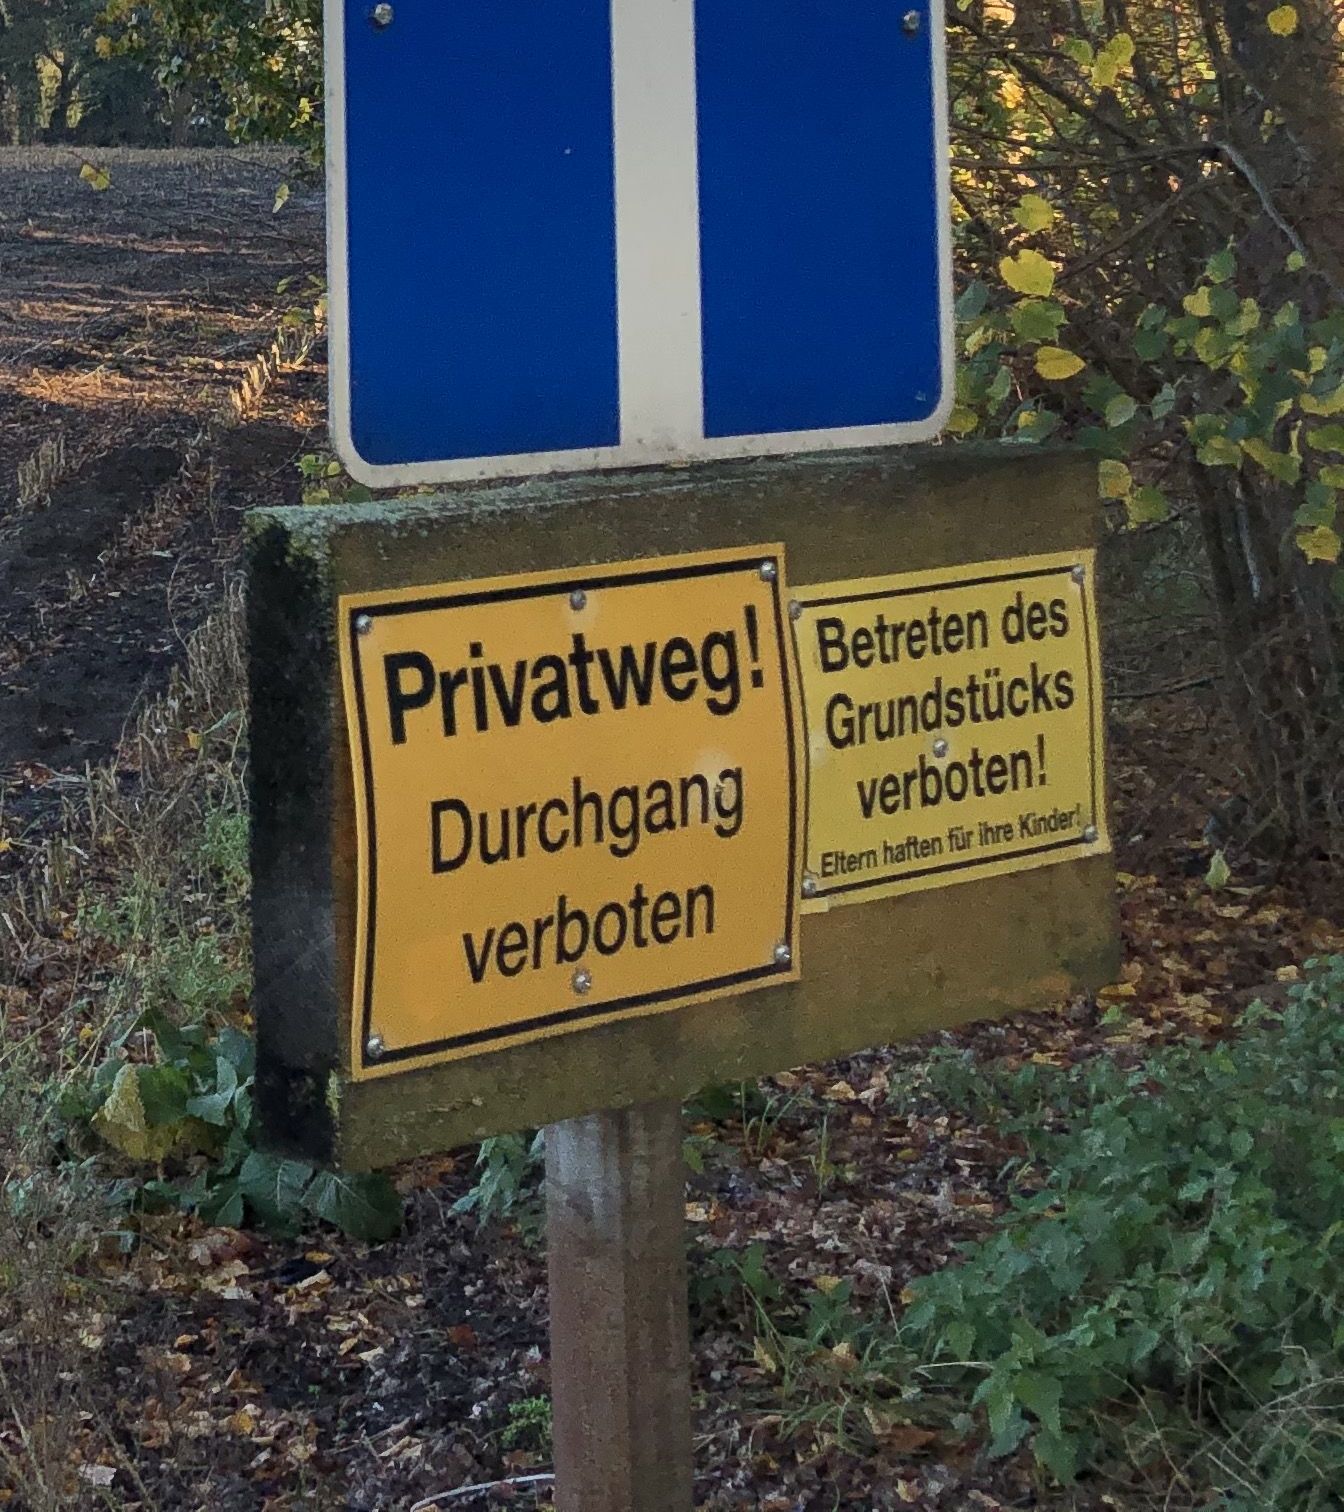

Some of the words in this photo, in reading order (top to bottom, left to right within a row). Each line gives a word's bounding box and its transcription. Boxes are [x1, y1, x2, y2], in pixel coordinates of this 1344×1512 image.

[383, 604, 765, 746] Privatweg!
[816, 606, 990, 674] Betreten
[1001, 591, 1070, 645] des
[825, 662, 1075, 751] Grundstücks
[430, 766, 744, 876] Durchgang
[856, 733, 1048, 820] verboten!
[820, 850, 879, 879] Eltern
[882, 834, 944, 867] haften
[948, 824, 974, 852] für
[1017, 802, 1082, 840] Kinder!
[462, 882, 716, 985] verboten
